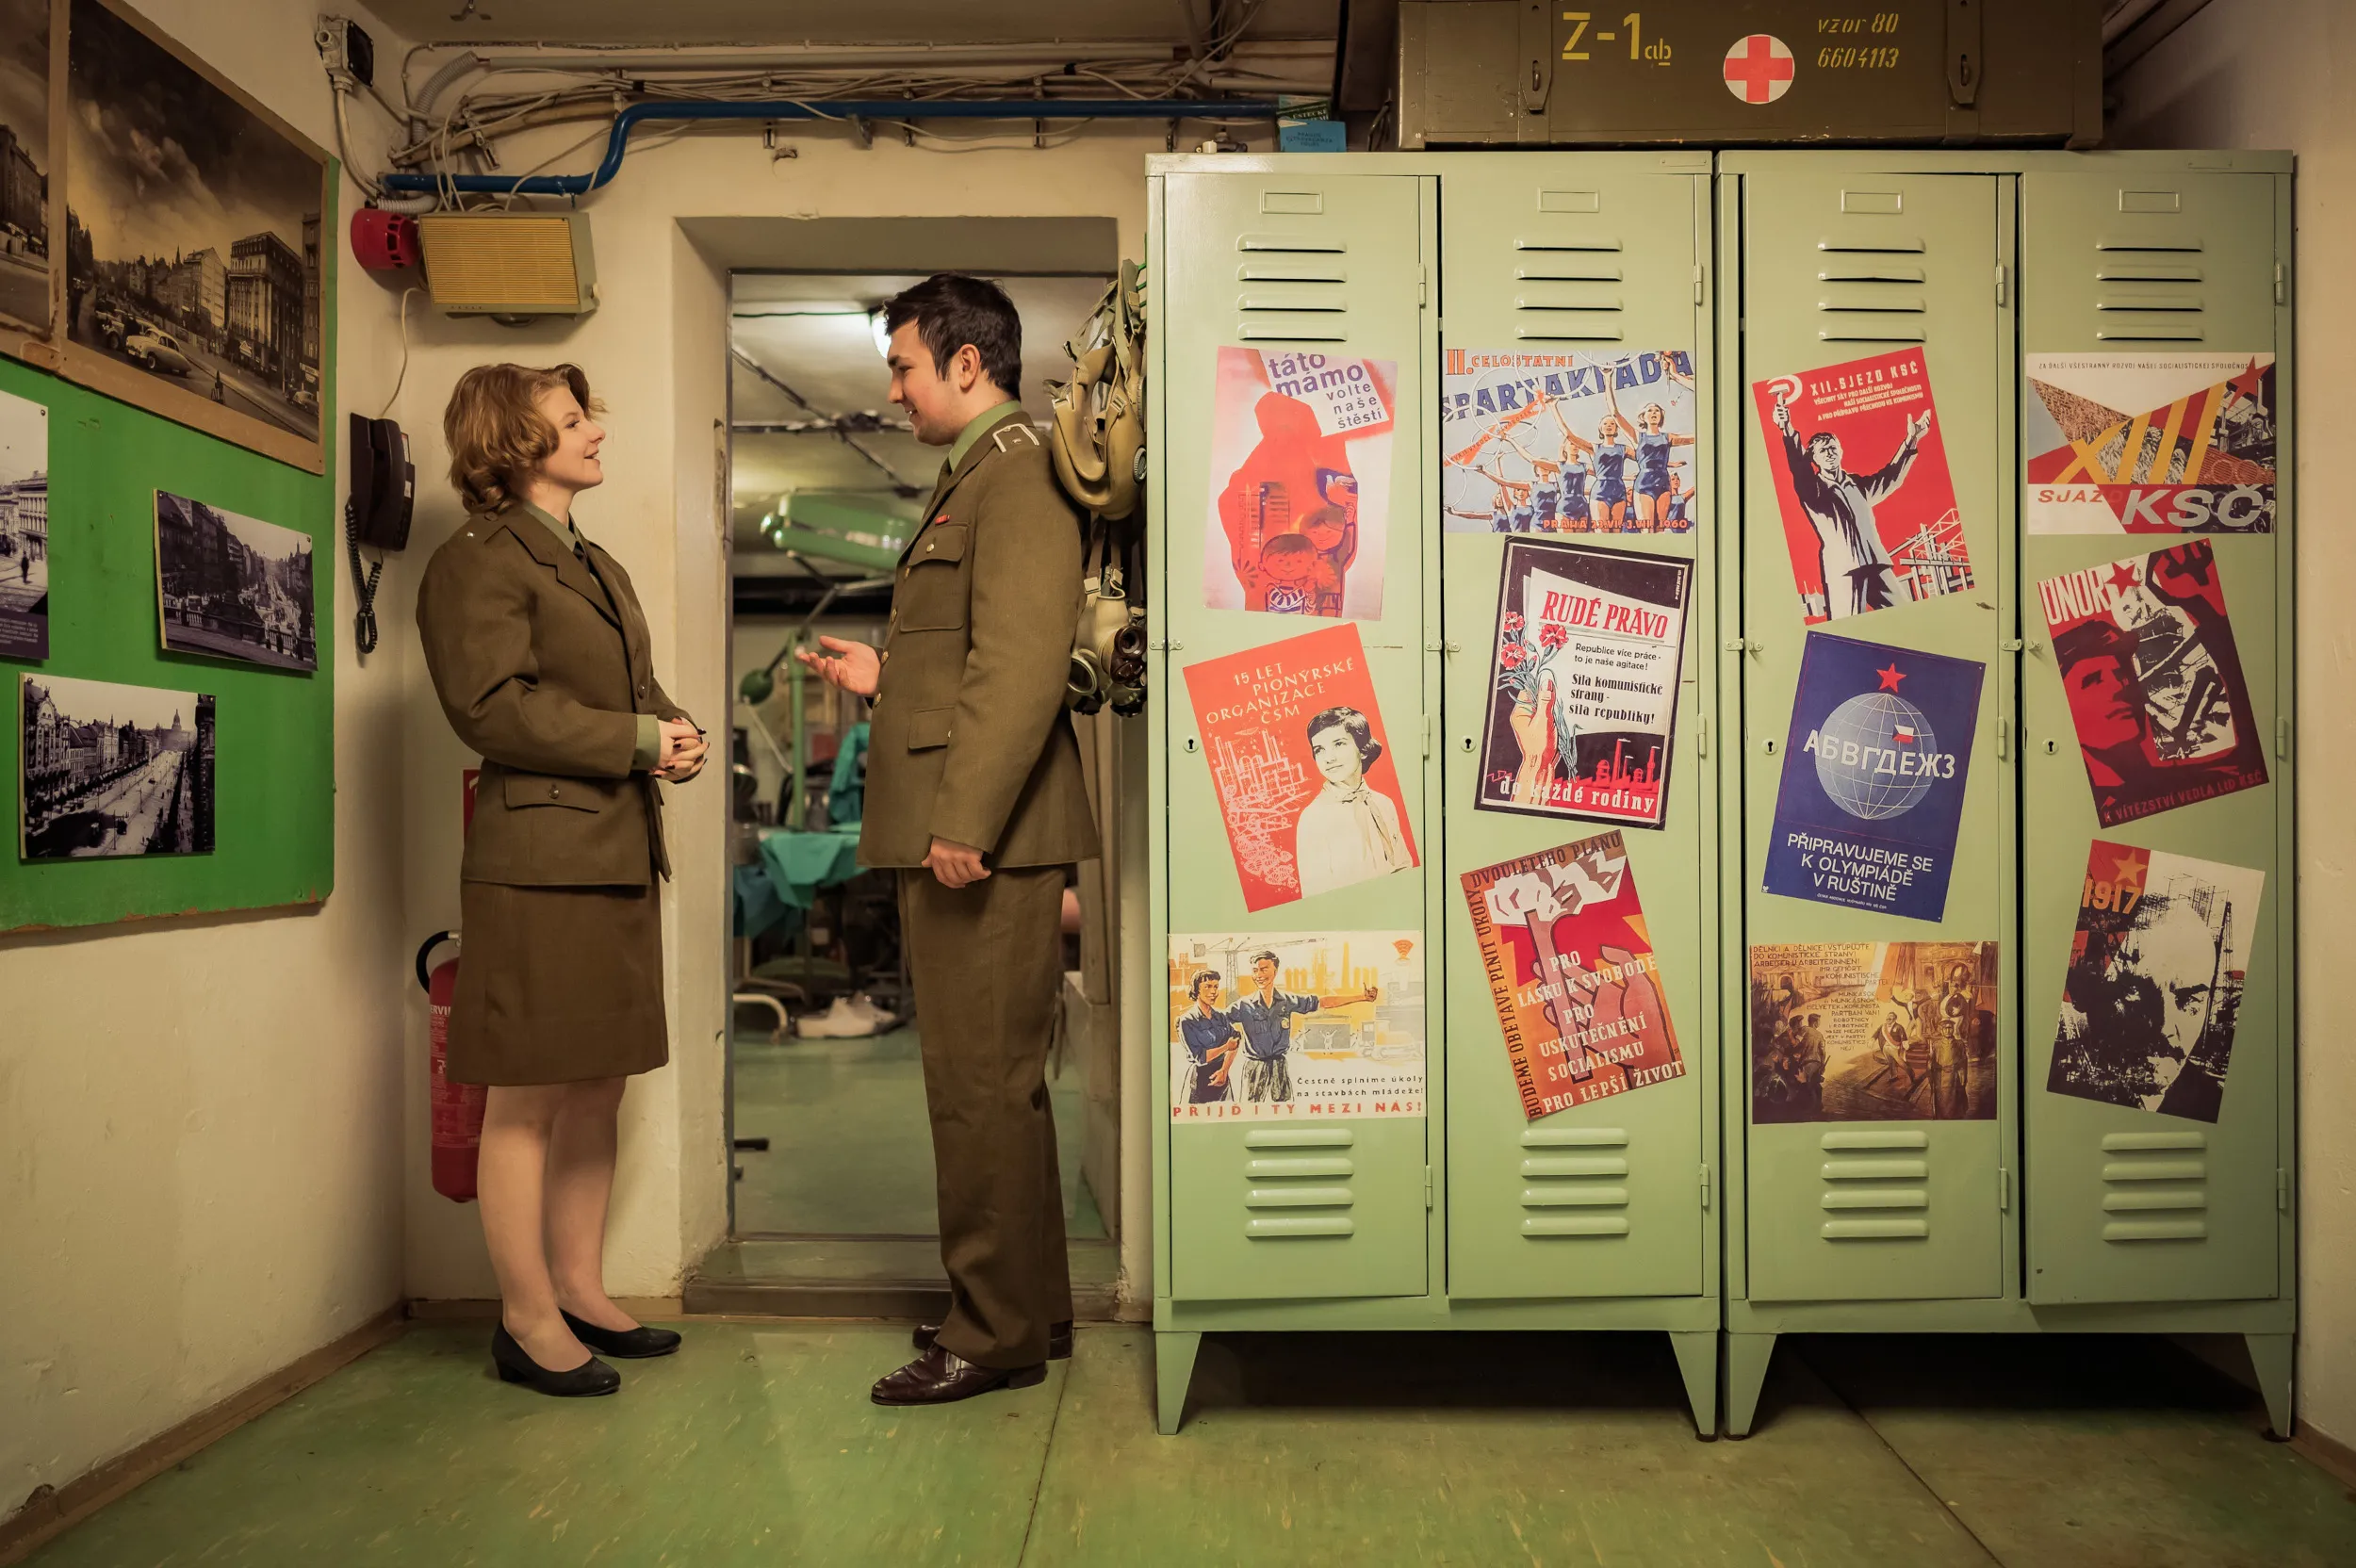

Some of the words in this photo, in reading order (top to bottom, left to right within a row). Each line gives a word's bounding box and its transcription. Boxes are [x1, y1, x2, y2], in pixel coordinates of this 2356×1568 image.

[1818, 19, 1866, 33] vzor
[1871, 13, 1899, 33] 80
[1817, 47, 1900, 68] 6604113
[1268, 353, 1326, 379] táto
[1275, 364, 1364, 397] mámo
[1326, 382, 1372, 401] volte
[1442, 351, 1694, 425] SPARTAKIÁDA
[1333, 395, 1378, 415] naše
[1338, 406, 1383, 429] štěstí
[2120, 483, 2264, 528] KSČ
[1543, 518, 1587, 530] PRAHA
[1660, 518, 1688, 530] 1960
[1539, 589, 1602, 628] RUDÉ
[1601, 603, 1670, 640] PRÁVO
[1575, 643, 1615, 655] Republice
[1617, 648, 1632, 657] více
[1634, 651, 1657, 662] práce
[1575, 654, 1582, 662] to
[1585, 655, 1593, 664] je
[1595, 658, 1614, 666] naše
[1616, 660, 1648, 671] agitace!
[1233, 671, 1250, 687] 15
[1255, 662, 1284, 682] LET
[1252, 657, 1355, 696] PIONÝRSKÉ
[1595, 677, 1663, 695] komunistické
[1206, 681, 1327, 725] ORGANIZACE
[1570, 688, 1604, 703] strany
[1261, 704, 1301, 725] ČSM
[1595, 707, 1655, 726] republiky!
[1803, 728, 1955, 779] АБВГДЕЖЗ
[1499, 776, 1521, 796] do
[1591, 790, 1655, 813] rodiny
[2177, 784, 2215, 803] VEDLA
[2217, 778, 2235, 792] LID
[1787, 831, 1908, 869] PŘIPRAVUJEME
[1911, 856, 1934, 873] SE
[1801, 853, 1813, 869] K
[1818, 856, 1914, 888] OLYMPIÁDĚ
[1813, 873, 1825, 888] V
[1826, 874, 1897, 902] RUŠTINĚ
[2081, 878, 2142, 915] 1917
[1481, 941, 1505, 984] PLNIT
[1549, 950, 1581, 972] PRO
[1516, 982, 1562, 1008] LÁSKU
[1565, 978, 1579, 994] K
[1581, 952, 1658, 991] SVOBODĚ
[1562, 1003, 1595, 1025] PRO
[1539, 1011, 1647, 1058] USKUTEČNĚNÍ
[1547, 1041, 1644, 1082] SOCIALISMU
[1391, 1075, 1423, 1084] úkoly
[1512, 1052, 1543, 1118] BUDEME
[1542, 1091, 1574, 1114] PRO
[1579, 1070, 1628, 1102] LEPŠÍ
[1633, 1059, 1684, 1087] ŽIVOT
[1271, 1103, 1296, 1115] TY
[1310, 1103, 1361, 1114] MEZI
[1375, 1100, 1422, 1113] NÁS!
